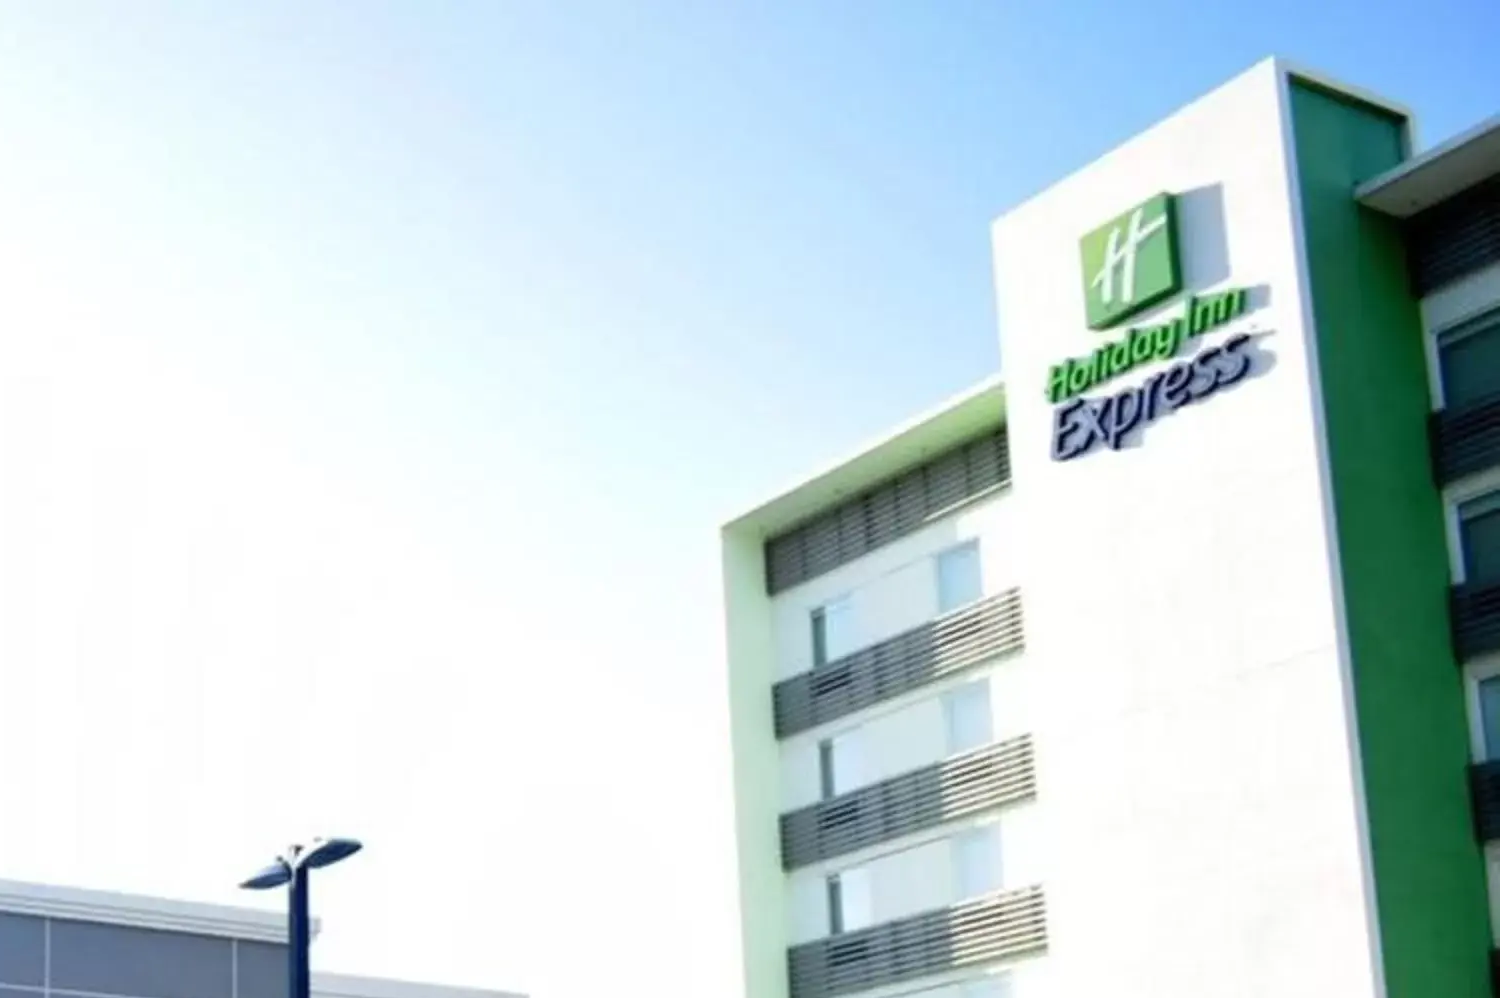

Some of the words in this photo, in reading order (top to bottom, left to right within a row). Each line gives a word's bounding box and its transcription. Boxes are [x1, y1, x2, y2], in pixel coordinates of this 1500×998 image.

[1046, 319, 1184, 403] Holiday
[1184, 290, 1247, 337] Inn
[1051, 334, 1252, 462] Express
